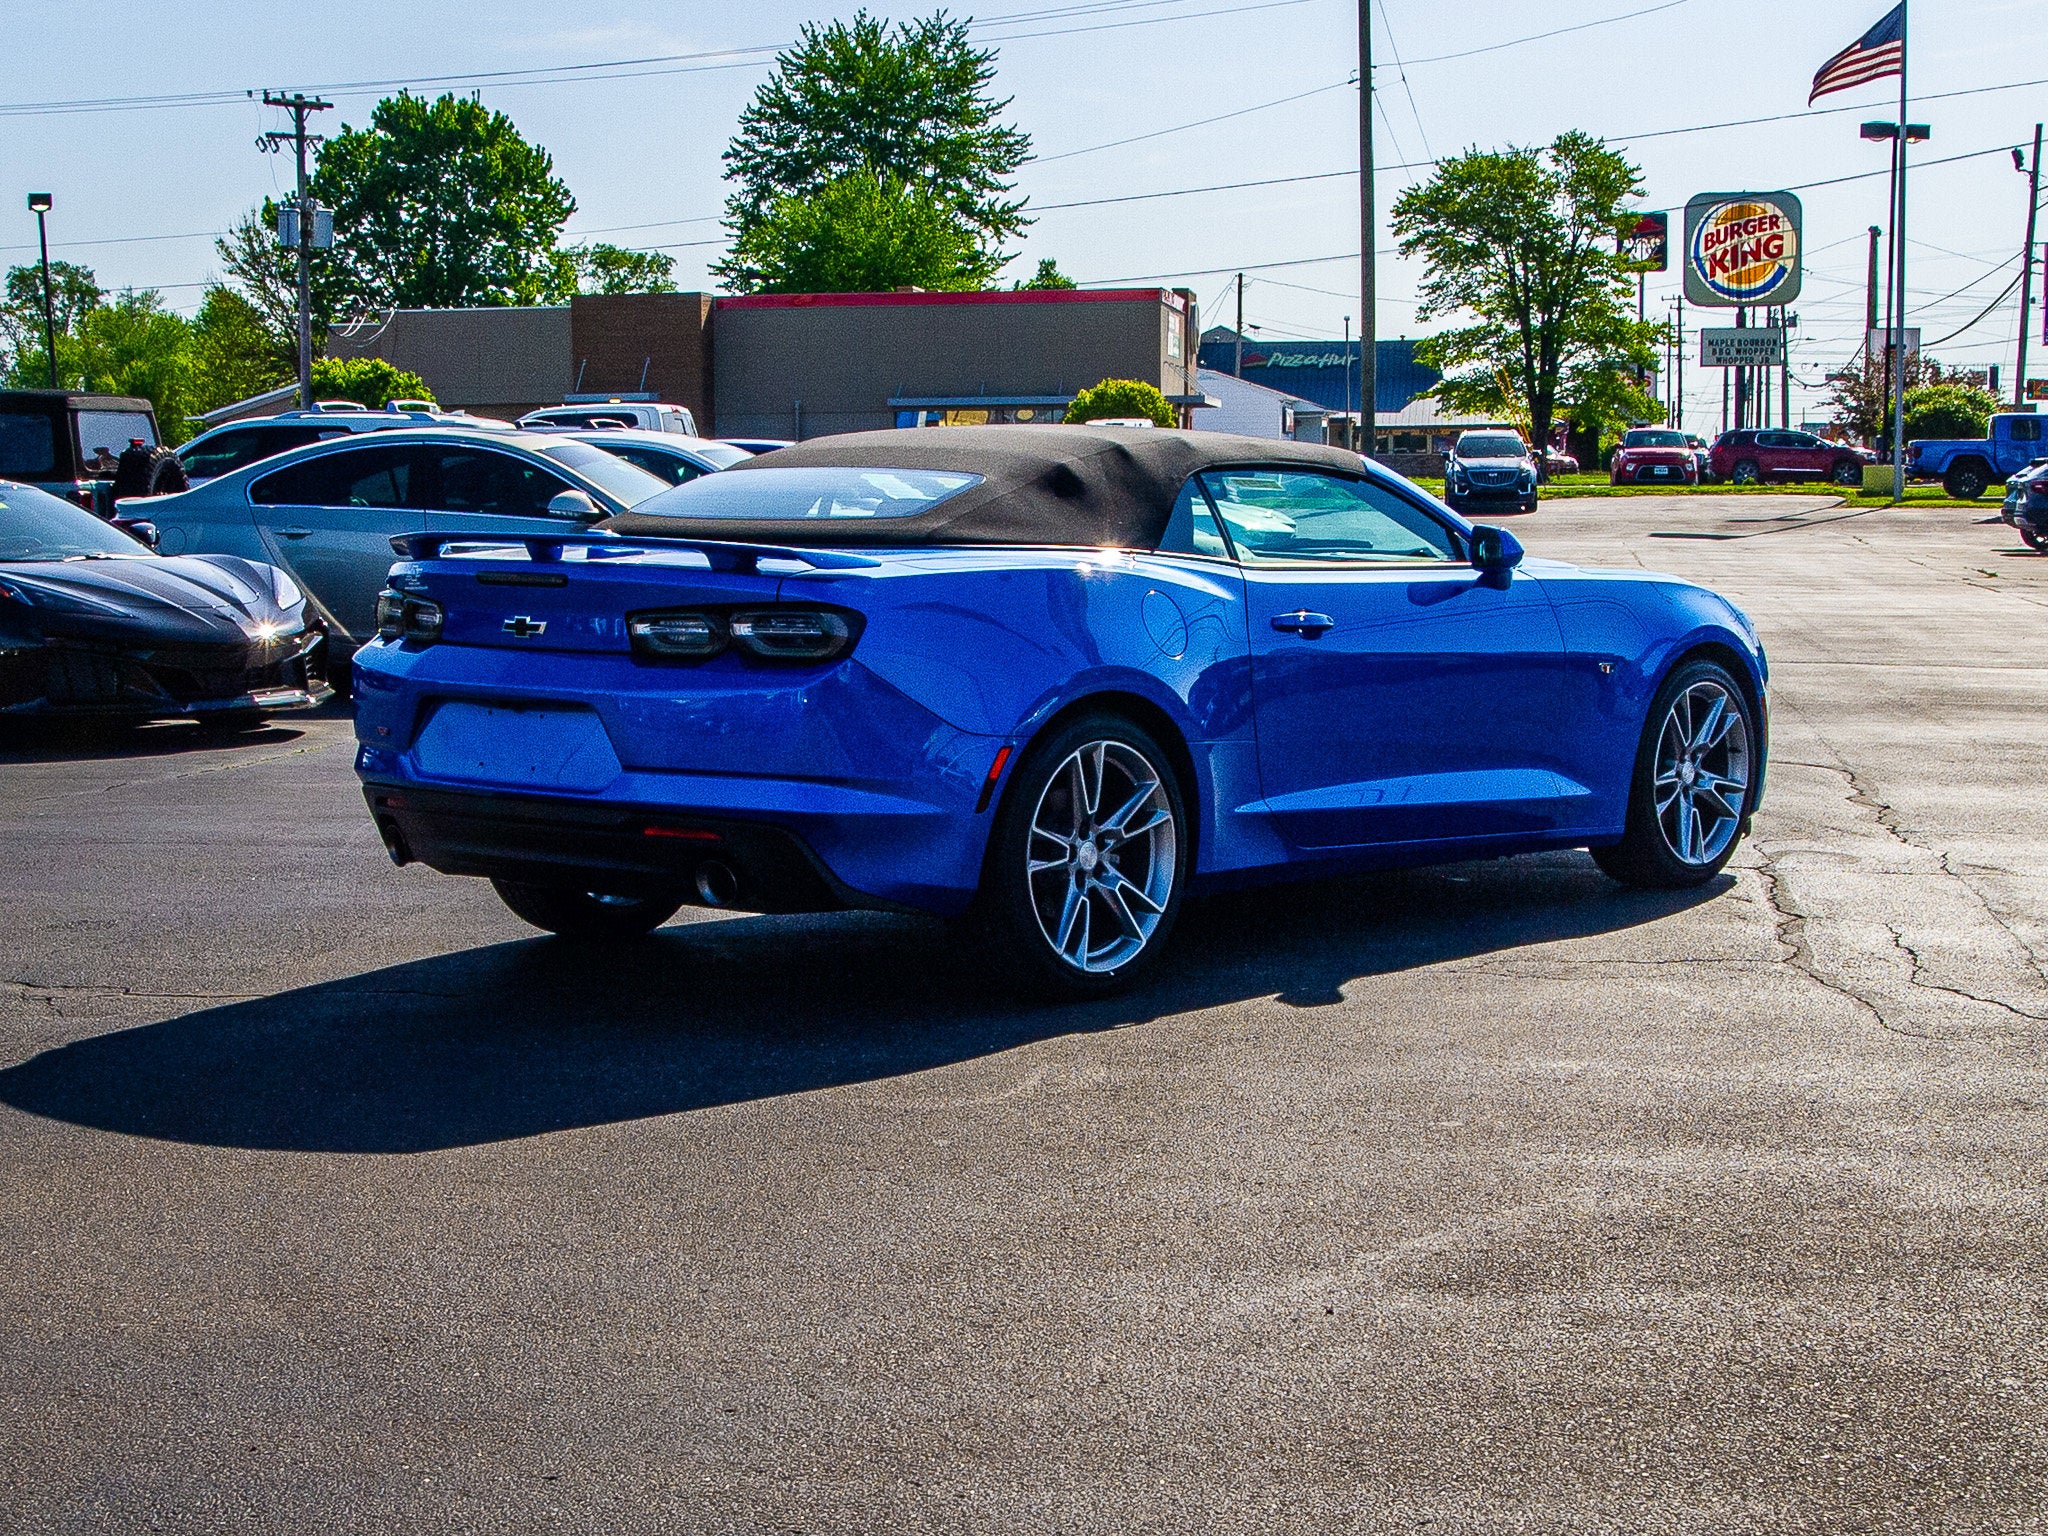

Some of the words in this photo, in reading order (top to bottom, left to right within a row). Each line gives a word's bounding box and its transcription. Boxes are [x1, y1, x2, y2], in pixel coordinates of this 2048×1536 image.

[1703, 214, 1780, 252] BURGER
[1709, 234, 1784, 279] KING
[1708, 339, 1734, 347] MAPLE
[1737, 339, 1777, 347] BOURBON
[1712, 348, 1731, 356] BBQ
[1735, 348, 1776, 356] WHOPPER
[1267, 352, 1318, 368] Pizza
[1318, 352, 1359, 368] Hut
[1716, 357, 1754, 365] WHOPPER
[1759, 357, 1770, 365] JR
